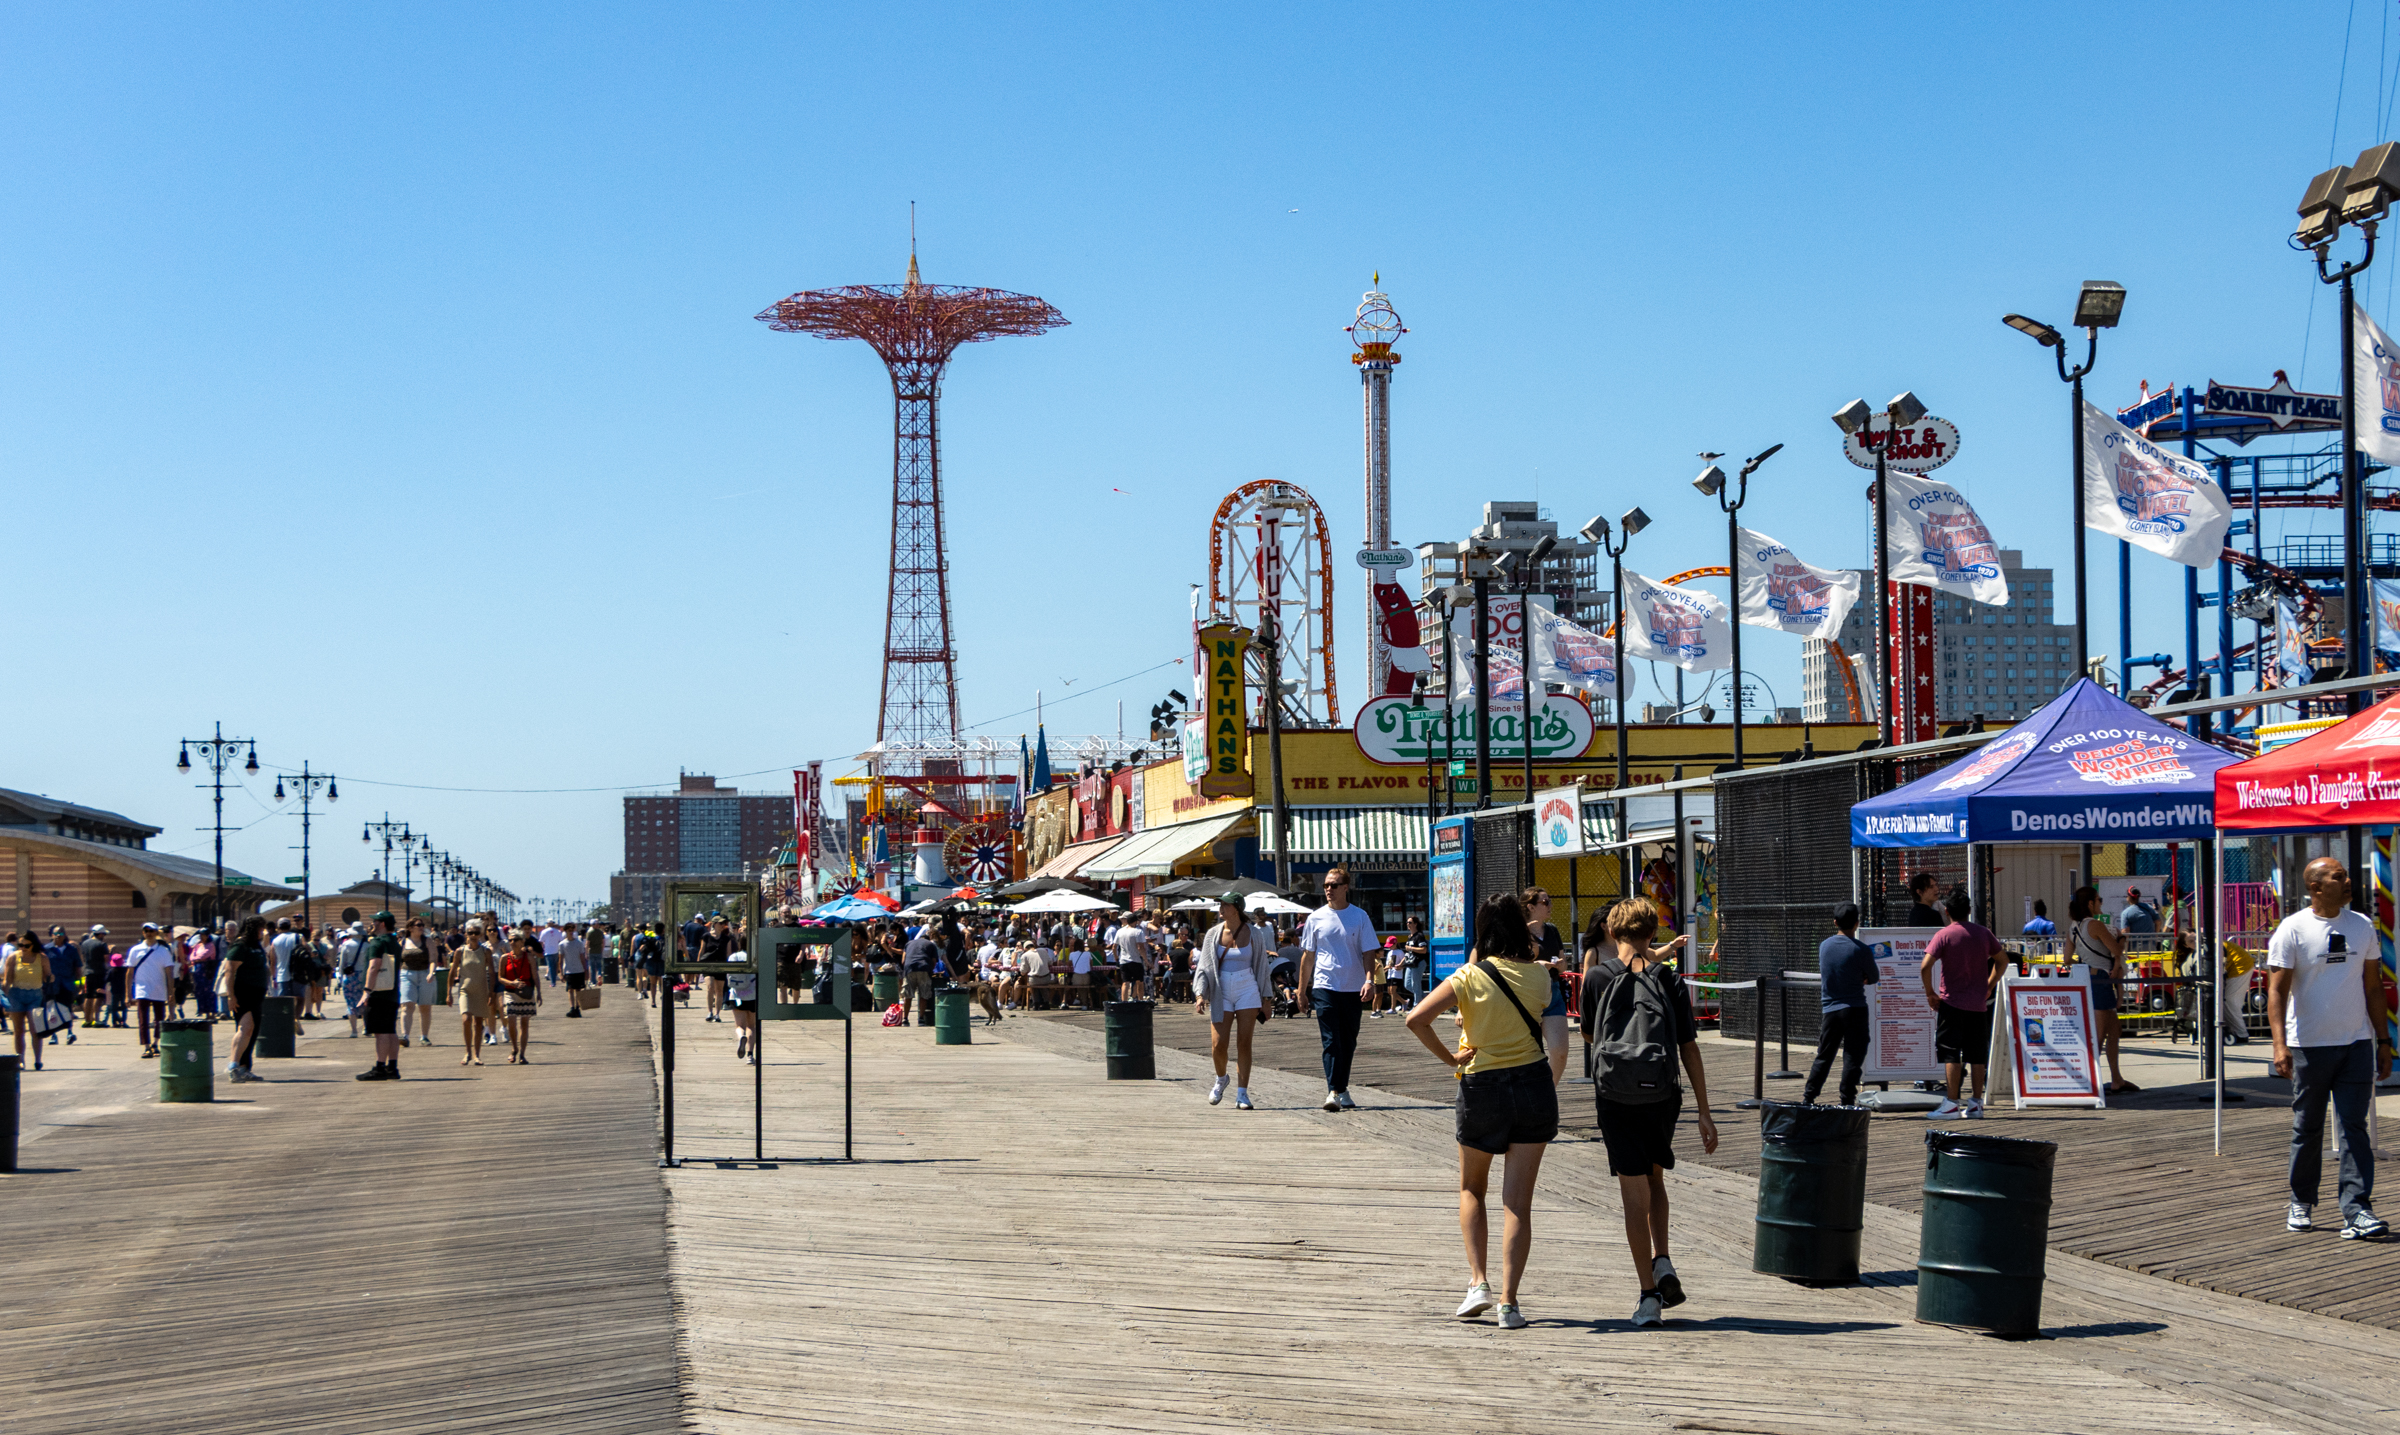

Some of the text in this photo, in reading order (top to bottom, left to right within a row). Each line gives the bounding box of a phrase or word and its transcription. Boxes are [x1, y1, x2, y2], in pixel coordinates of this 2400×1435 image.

[2292, 396, 2343, 420] EAGL
[1922, 427, 1938, 443] &
[1886, 442, 1946, 460] SHOUT
[2135, 440, 2159, 459] 100
[1909, 490, 1964, 510] OVER 100
[2135, 494, 2191, 521] WHEEL
[1928, 511, 1976, 527] DENO'S
[2130, 520, 2152, 532] CONEY
[1362, 551, 1406, 564] Nathan's
[1926, 553, 1996, 576] SINCE 1920
[1944, 544, 1999, 571] WHEEL
[1940, 571, 1962, 581] CONEY
[1680, 593, 1713, 619] YEARS
[1783, 615, 1802, 623] CONEY
[1557, 633, 1598, 645] DENO'S
[1552, 641, 1614, 661] WONDER
[1569, 659, 1616, 674] WHEEL
[1216, 640, 1237, 774] NATHANS
[1488, 704, 1525, 713] Since 191
[2049, 729, 2188, 754] OVER 100 YEARS
[2074, 739, 2145, 761] DENO'S
[1452, 748, 1511, 756] AMUS
[2068, 745, 2180, 774] WONDER
[2107, 759, 2190, 781] WHEEL
[1291, 777, 1330, 789] THE
[1338, 776, 1410, 789] FLAVOR
[1418, 775, 1442, 788] OF
[1559, 774, 1616, 787] SICE
[1626, 773, 1665, 786] 1916
[1458, 781, 1476, 791] W 1
[2236, 780, 2293, 810] Welcome
[2294, 779, 2309, 805] to
[2308, 773, 2365, 809] Famiglia
[1541, 799, 1555, 826] HAPPY
[2011, 804, 2213, 832] DenosWonderWh
[809, 764, 820, 885] THUNDERBOLT
[1866, 813, 1954, 834] A PLACE FOR FUN AND FAMILY!
[1352, 861, 1429, 871] AuntieAnne
[1895, 940, 1927, 949] Deno's FUN
[2027, 996, 2071, 1006] BIG FUN CARD
[2023, 1006, 2078, 1018] Savings for 2025
